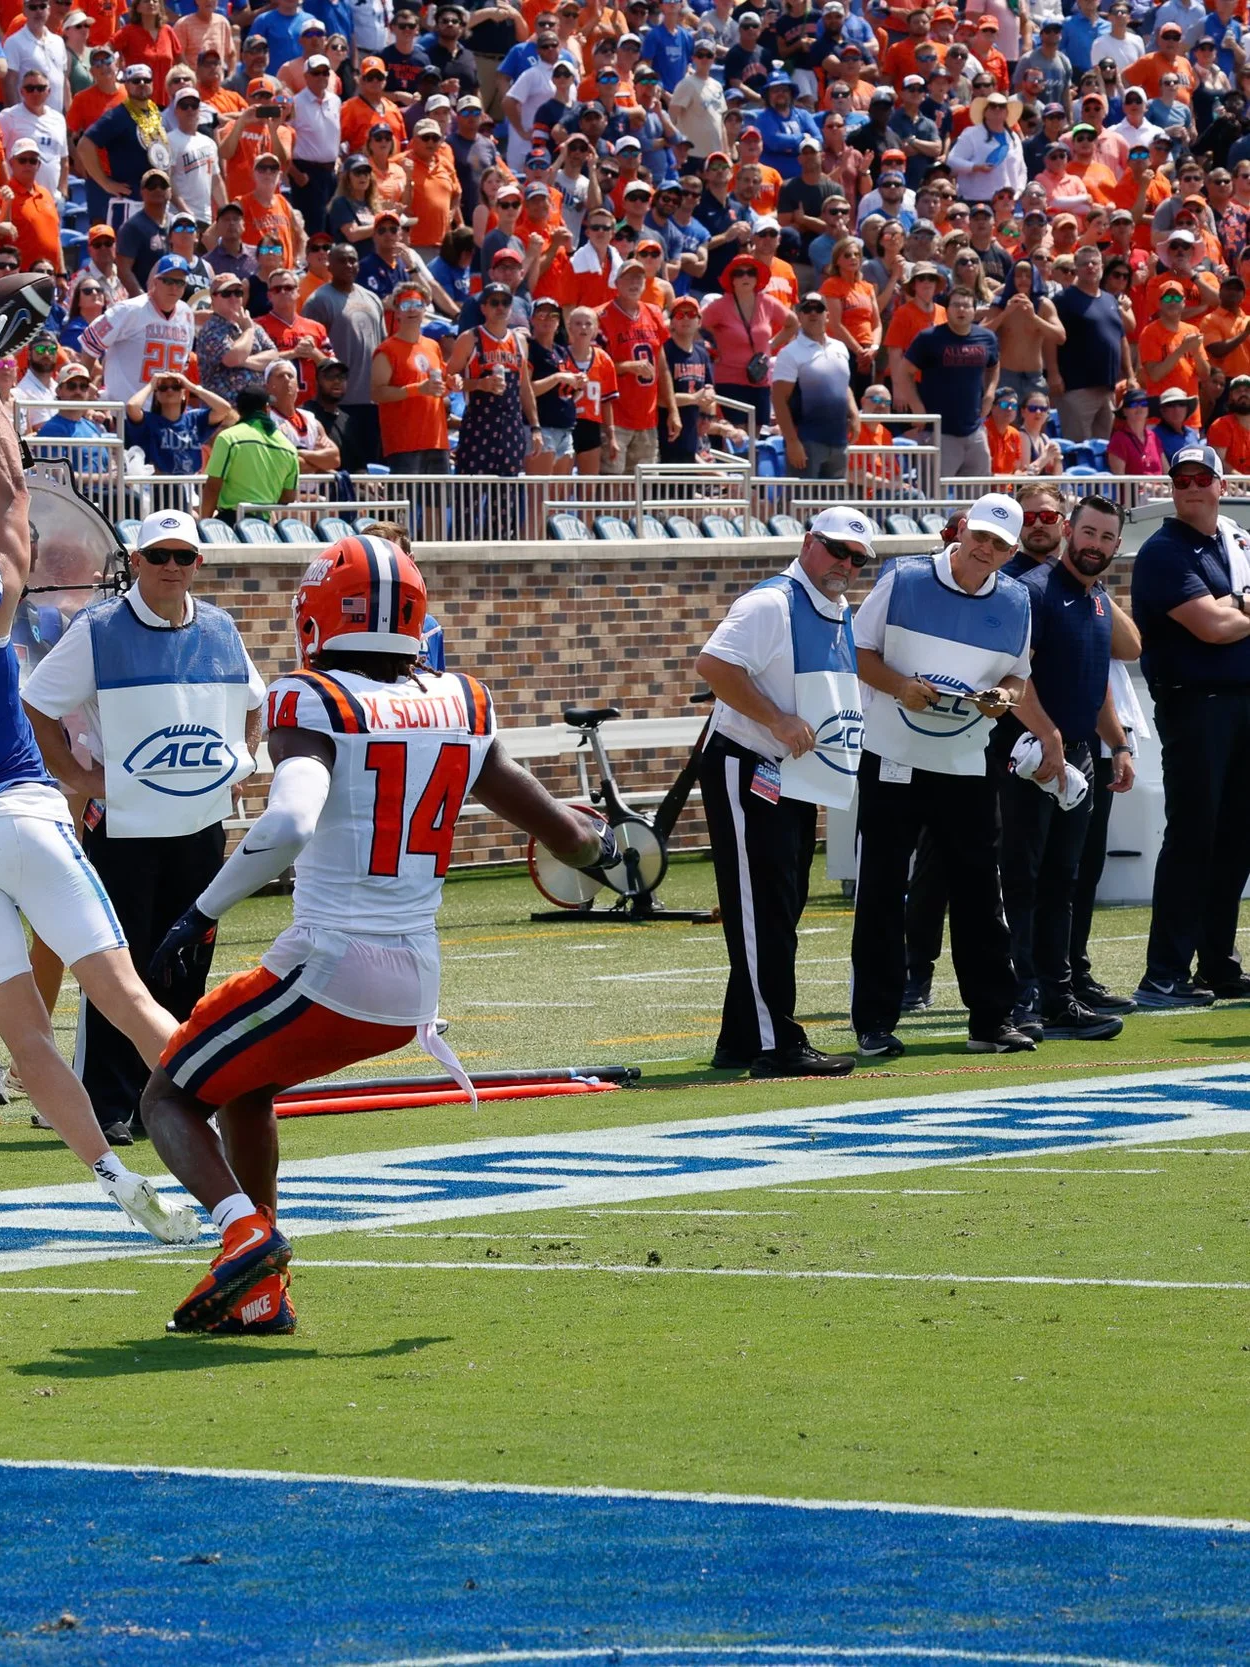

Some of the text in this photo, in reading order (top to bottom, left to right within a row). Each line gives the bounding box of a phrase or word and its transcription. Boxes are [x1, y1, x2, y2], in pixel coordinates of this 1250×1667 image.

[268, 690, 300, 730] 14
[364, 697, 390, 730] X.
[391, 696, 448, 730] SCOTT
[819, 726, 864, 750] AC
[143, 741, 224, 770] ACC
[364, 741, 471, 878] 14
[240, 1293, 272, 1326] NIKE
